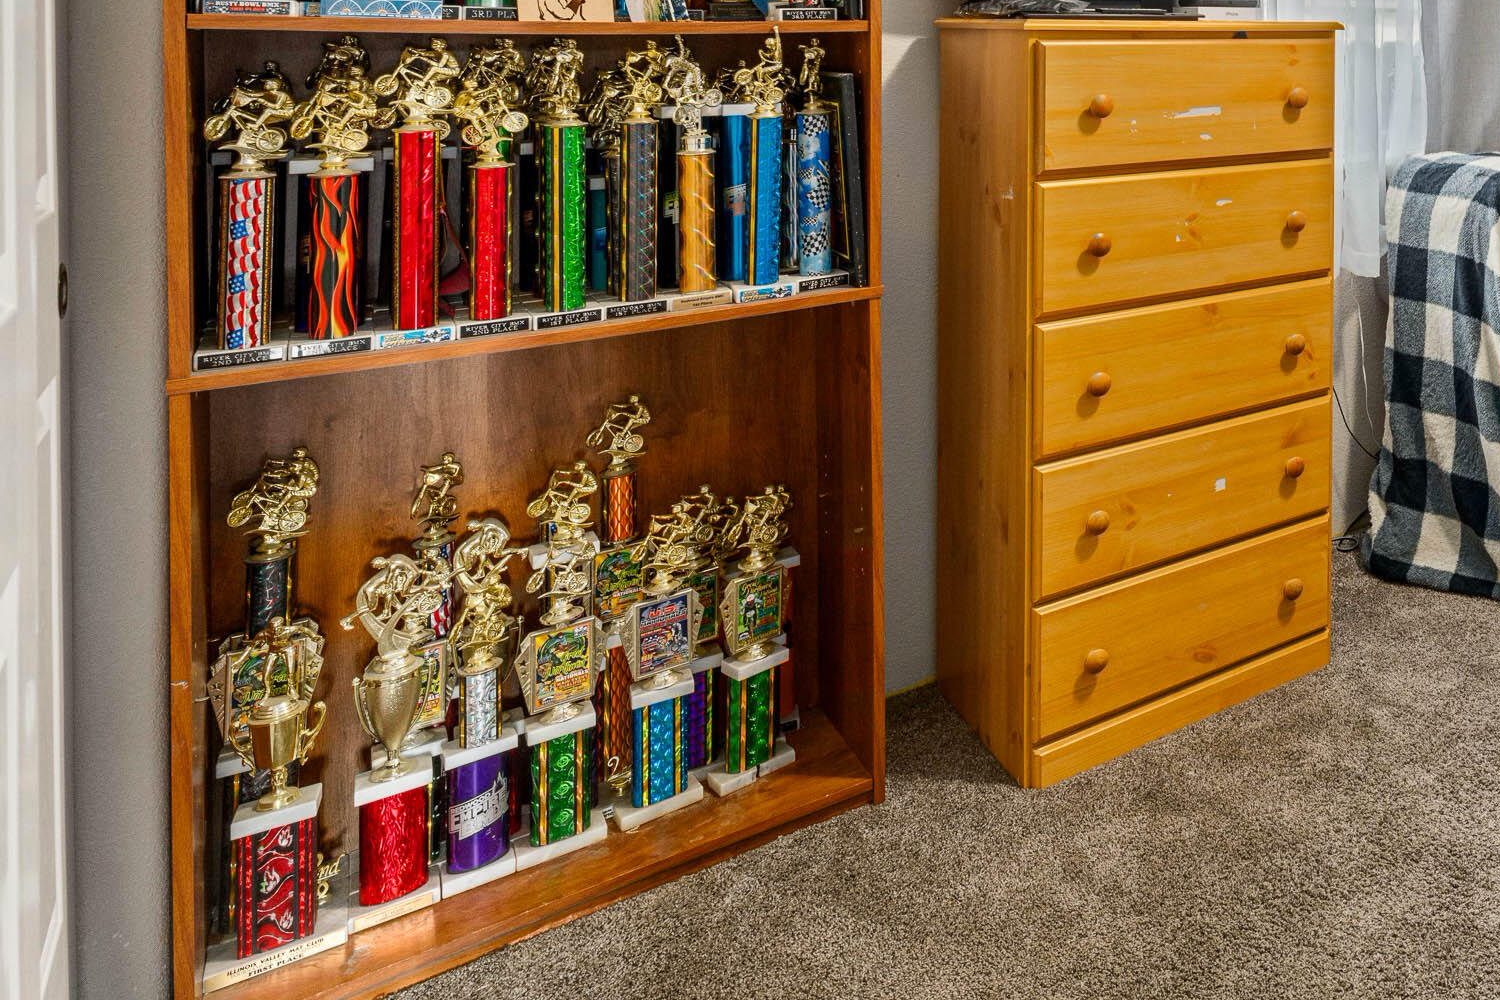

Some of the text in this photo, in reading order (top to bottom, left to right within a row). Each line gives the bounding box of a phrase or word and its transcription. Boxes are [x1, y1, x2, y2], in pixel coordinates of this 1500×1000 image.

[471, 8, 517, 19] 3RD PLA
[632, 306, 658, 314] PLACE
[542, 316, 563, 324] RIVER
[565, 316, 590, 325] PLACE
[493, 325, 519, 333] PLACE
[203, 354, 230, 363] RIVER
[234, 352, 251, 360] CITY
[211, 355, 268, 367] 2ND PLACE
[227, 963, 257, 977] ILLINOIS
[260, 952, 285, 964] VALLEY
[248, 953, 304, 977] FIRST PLACE
